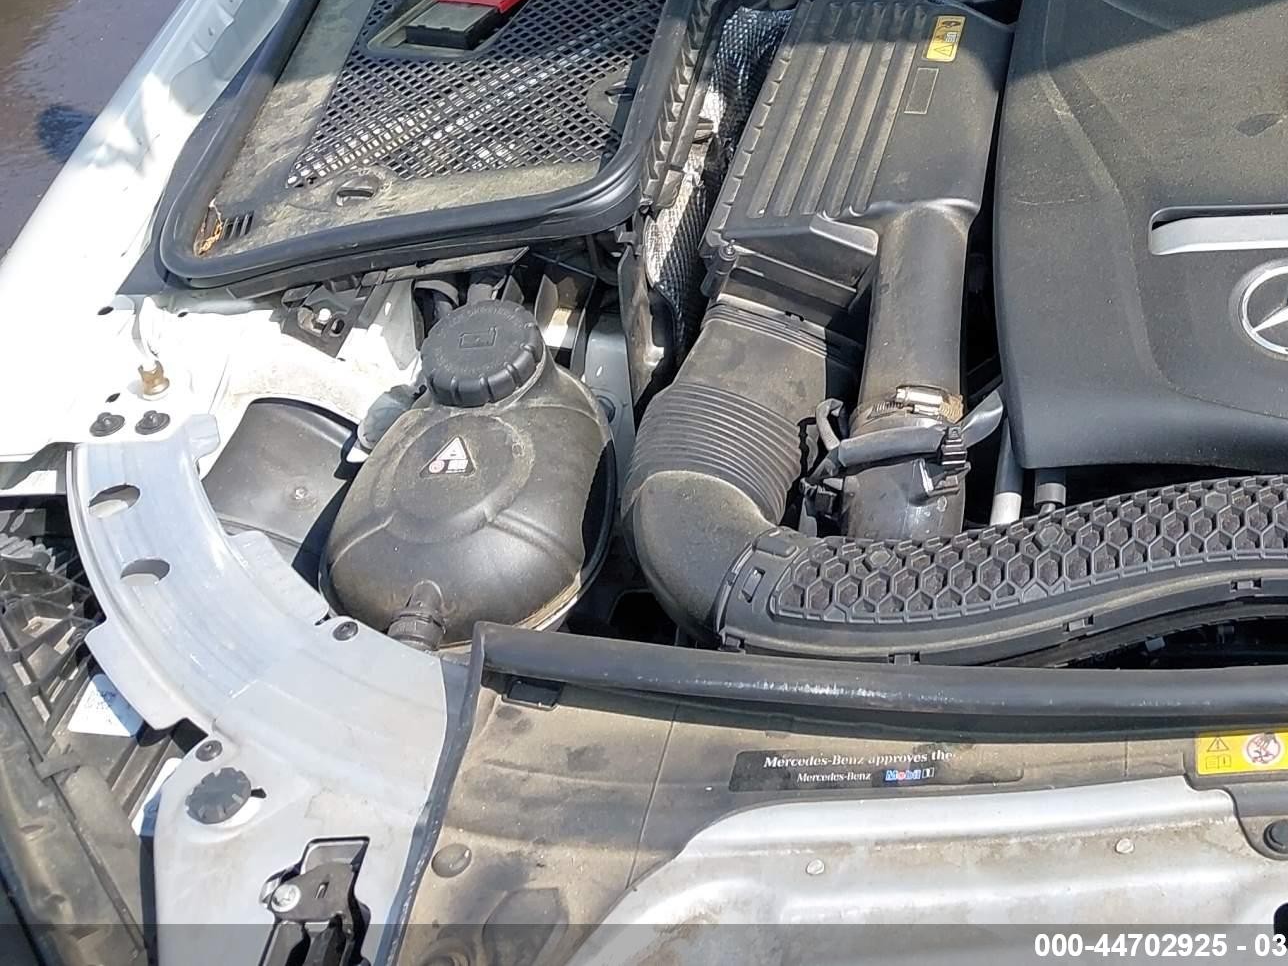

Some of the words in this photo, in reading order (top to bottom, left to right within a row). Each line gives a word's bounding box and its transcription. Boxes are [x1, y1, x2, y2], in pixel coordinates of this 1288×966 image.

[763, 752, 864, 768] Mercedes-Benz
[868, 753, 928, 766] approves
[797, 772, 872, 783] Mercedes-Benz
[885, 769, 921, 781] Mobil
